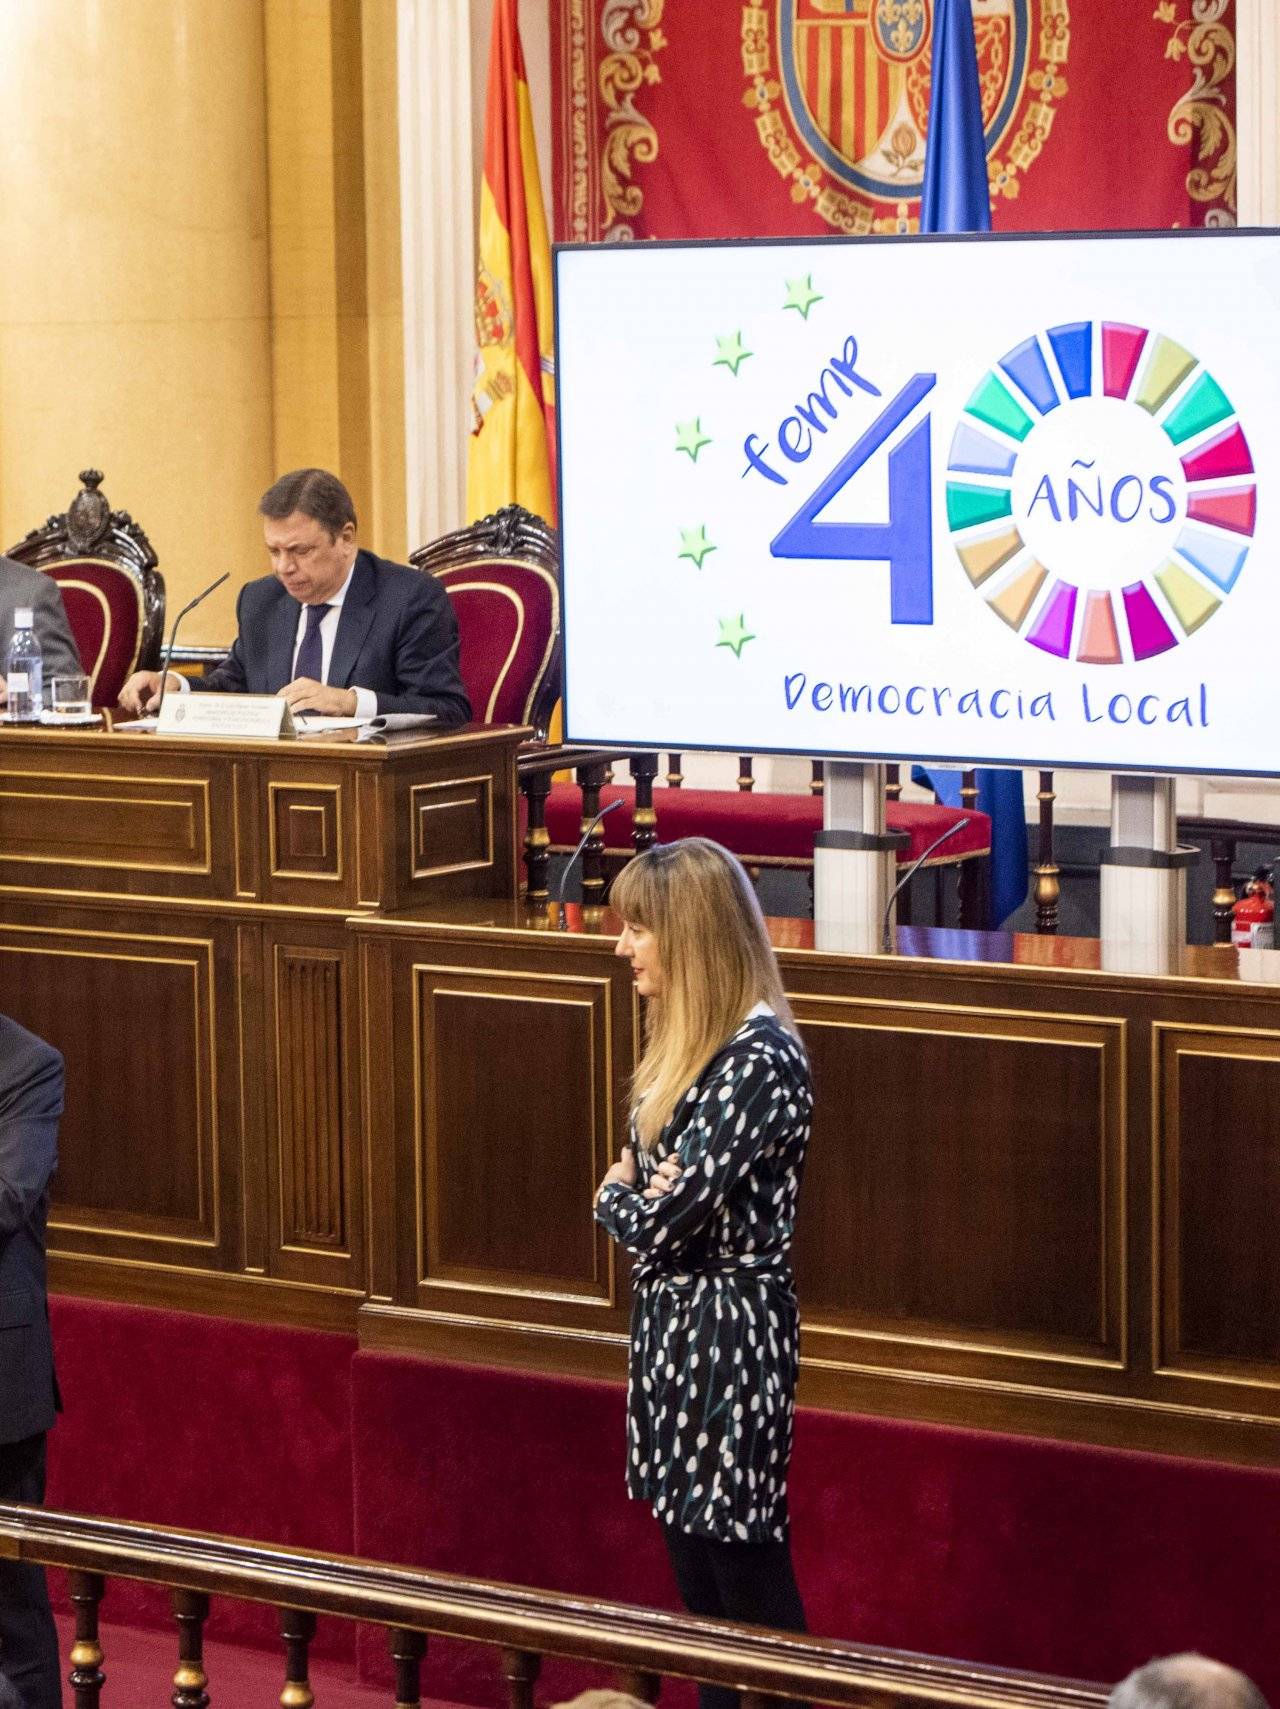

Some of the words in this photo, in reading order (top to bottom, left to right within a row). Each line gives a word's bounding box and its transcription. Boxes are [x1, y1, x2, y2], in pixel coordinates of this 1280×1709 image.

[1026, 458, 1177, 524] AÑOS
[784, 672, 1056, 721] Democracia
[1082, 682, 1210, 729] Local
